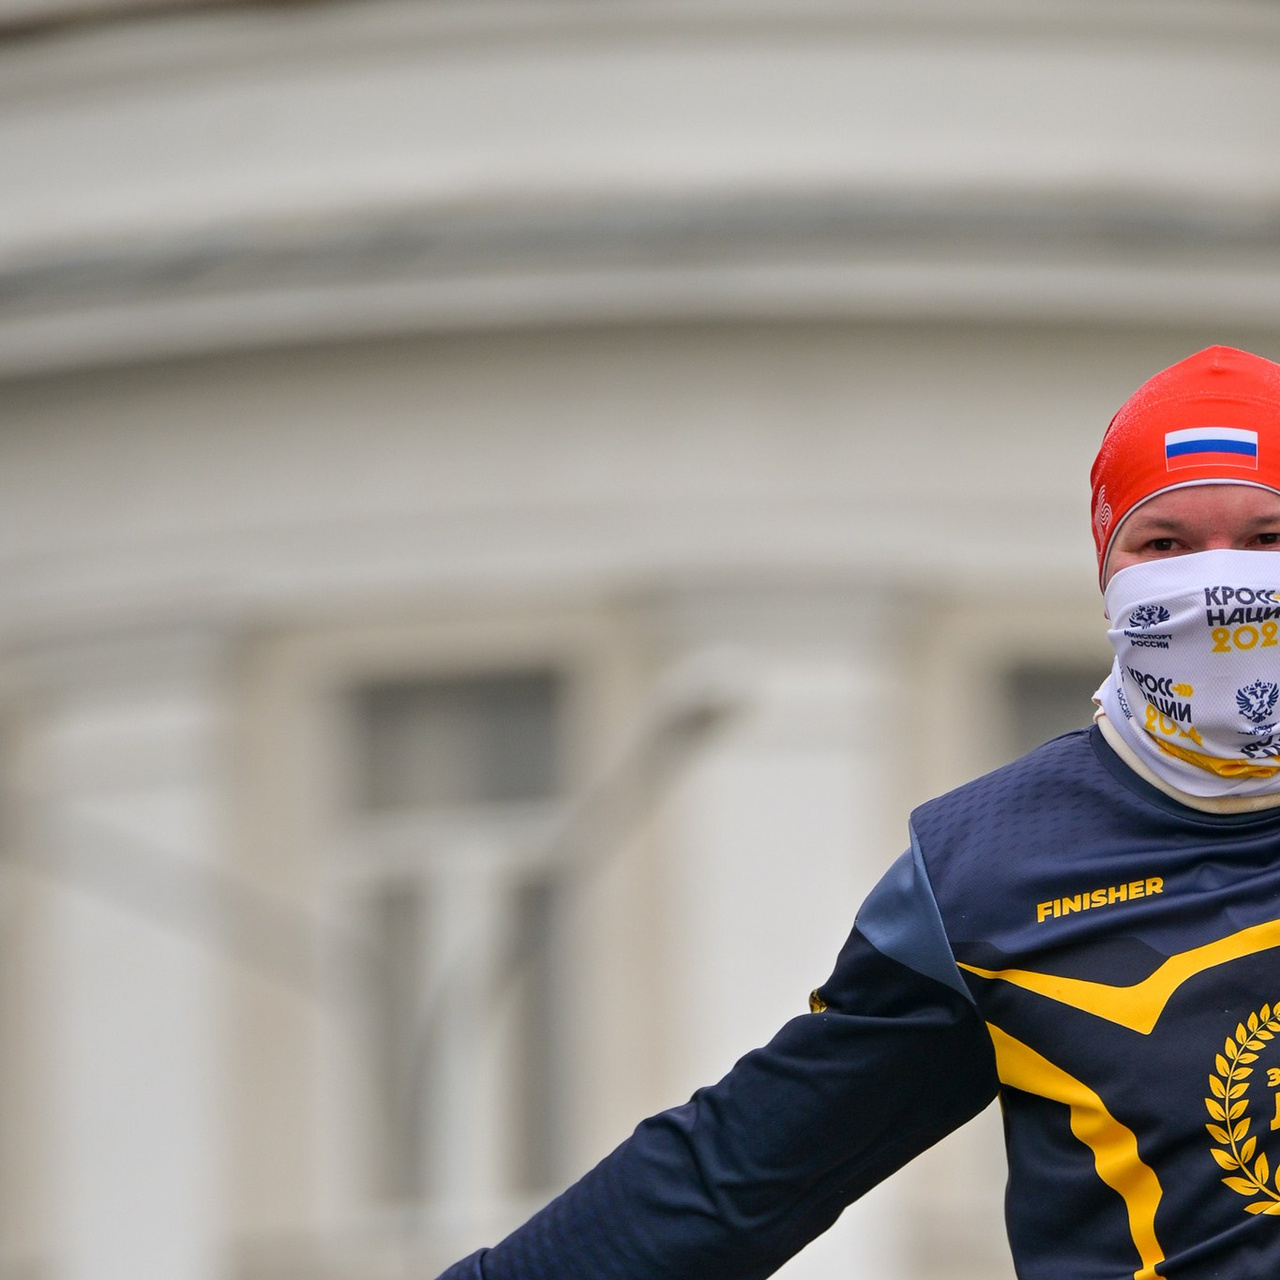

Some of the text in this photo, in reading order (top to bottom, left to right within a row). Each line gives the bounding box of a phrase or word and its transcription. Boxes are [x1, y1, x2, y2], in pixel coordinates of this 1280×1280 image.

[1204, 586, 1279, 606] КРОСС
[1123, 630, 1173, 640] МИНСПОРТ
[1130, 640, 1169, 649] РОССИИ
[1036, 876, 1164, 923] FINISHER
